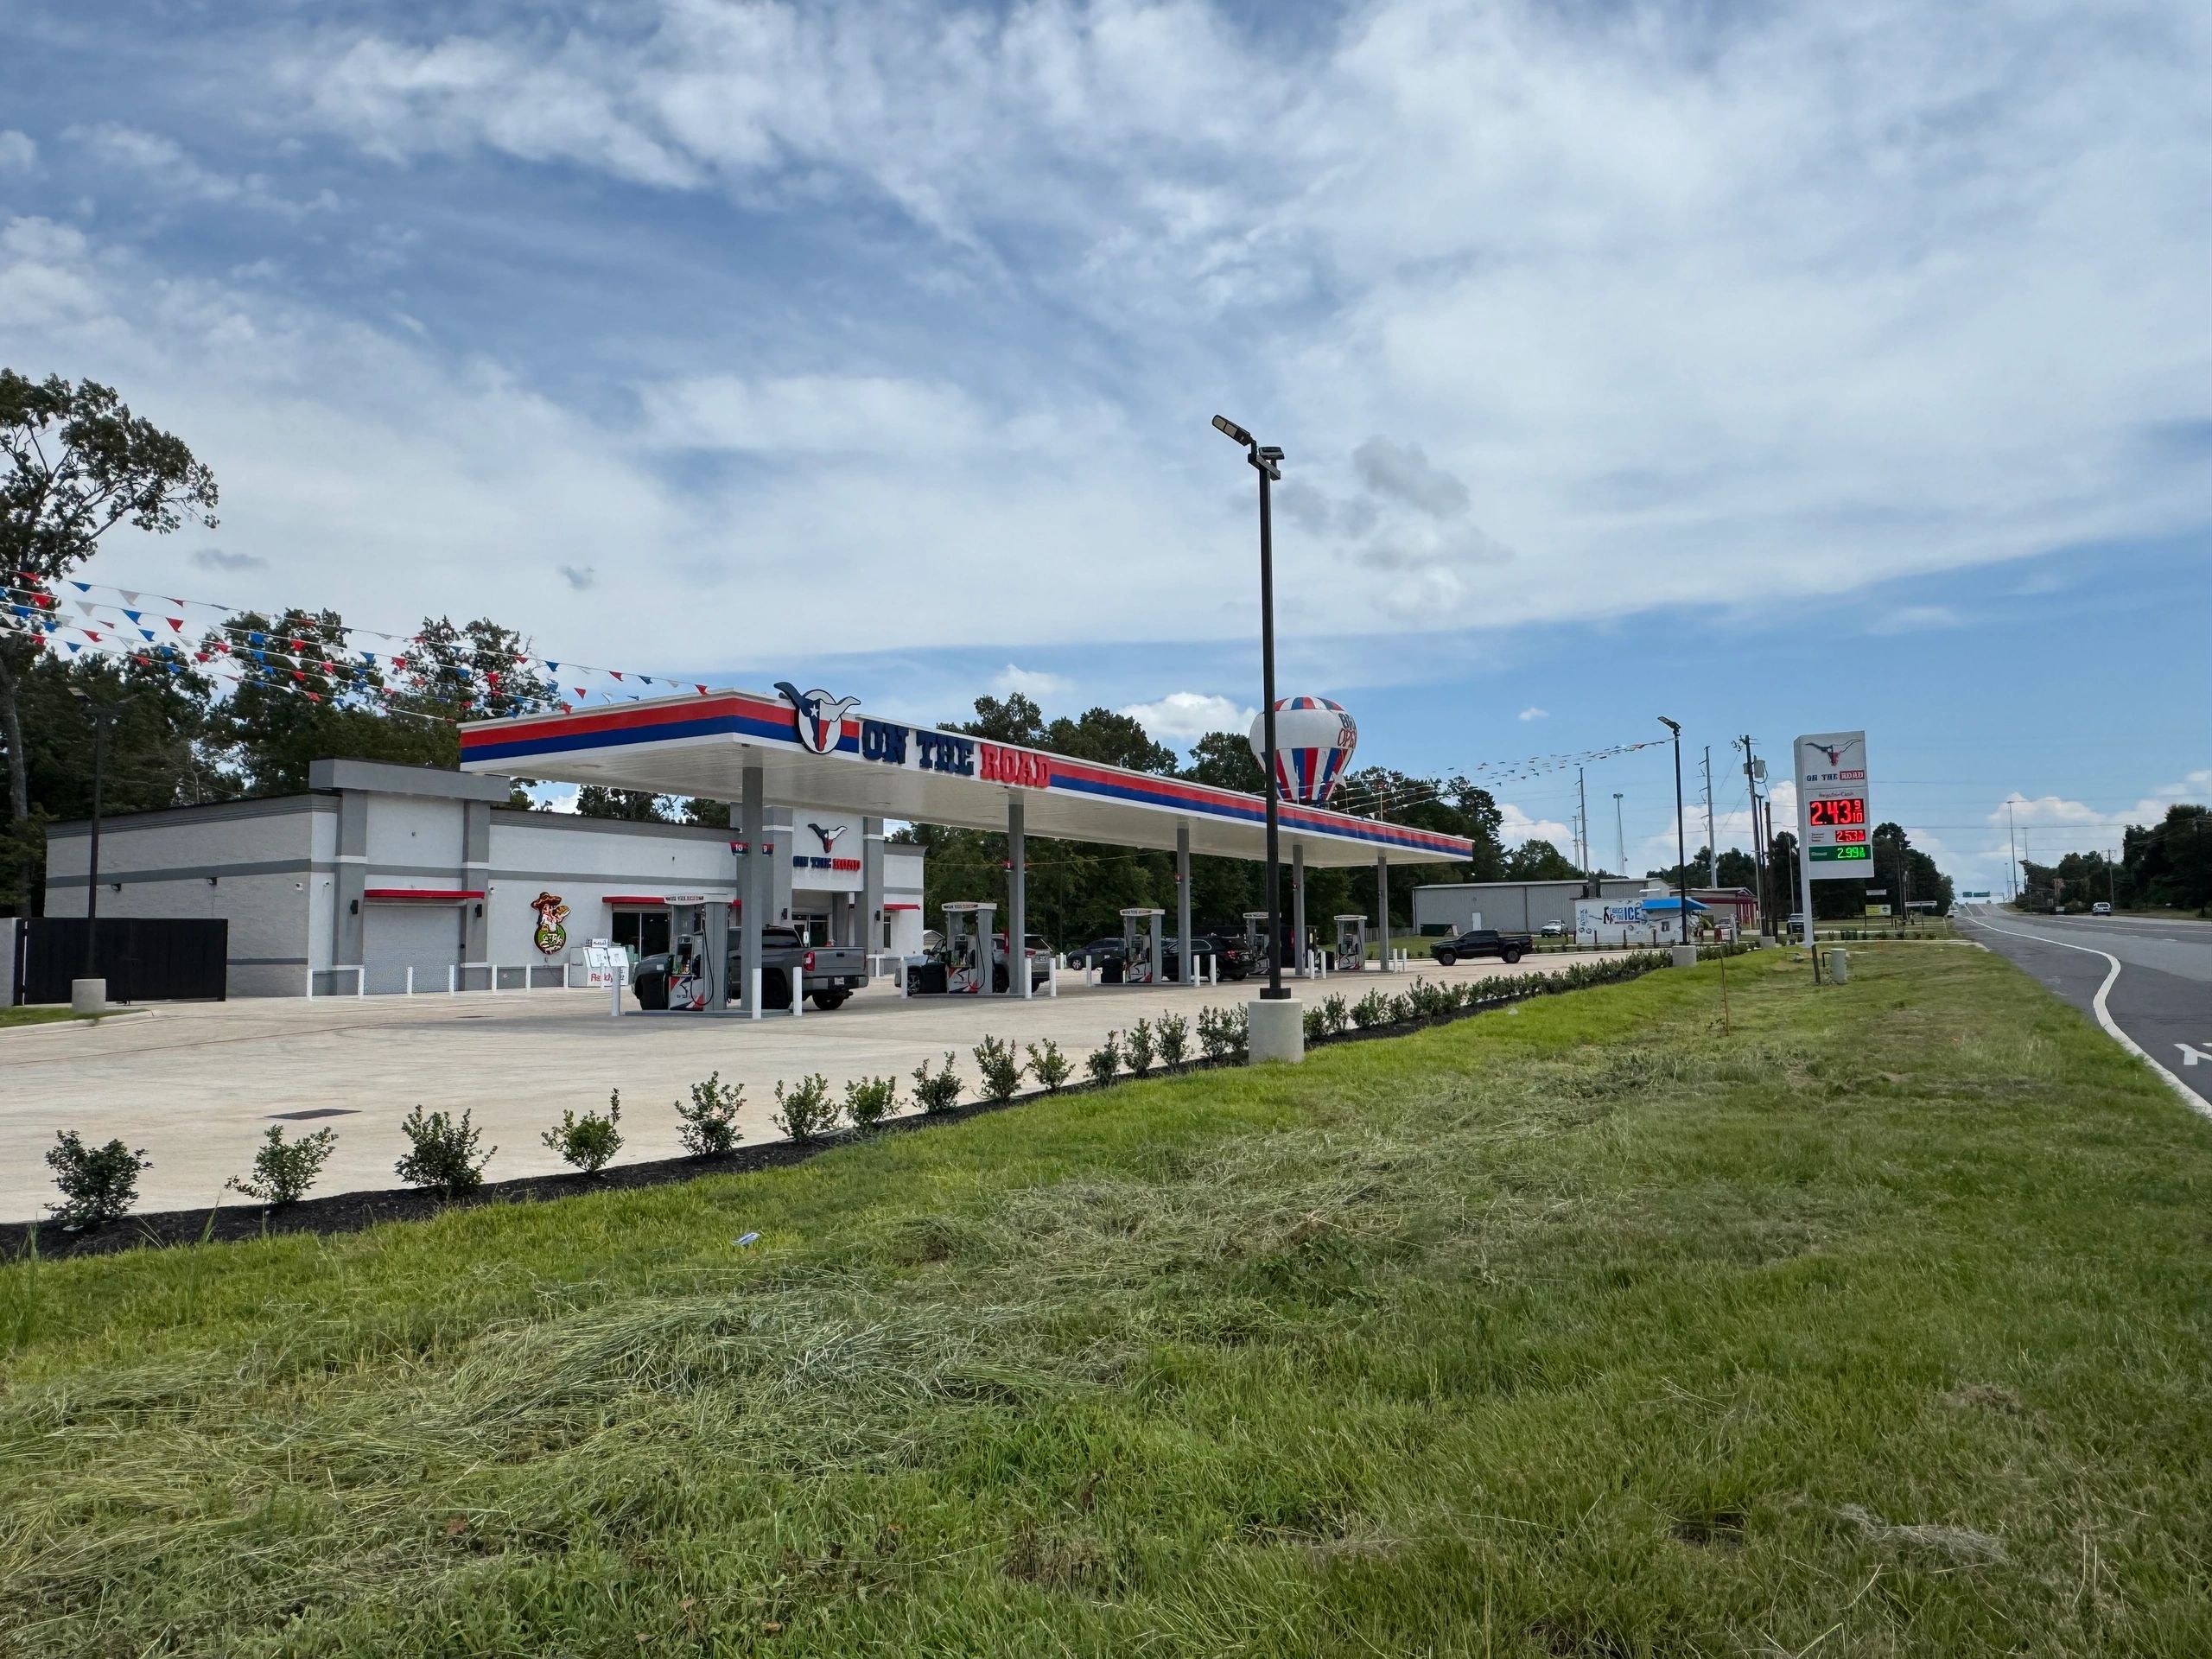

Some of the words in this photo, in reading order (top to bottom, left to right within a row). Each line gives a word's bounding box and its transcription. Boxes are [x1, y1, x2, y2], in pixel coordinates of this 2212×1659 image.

[862, 720, 909, 765] ON
[916, 730, 974, 776] THE
[980, 743, 1050, 788] ROAD
[1811, 800, 1851, 825] 2.43
[1624, 906, 1640, 920] ICE
